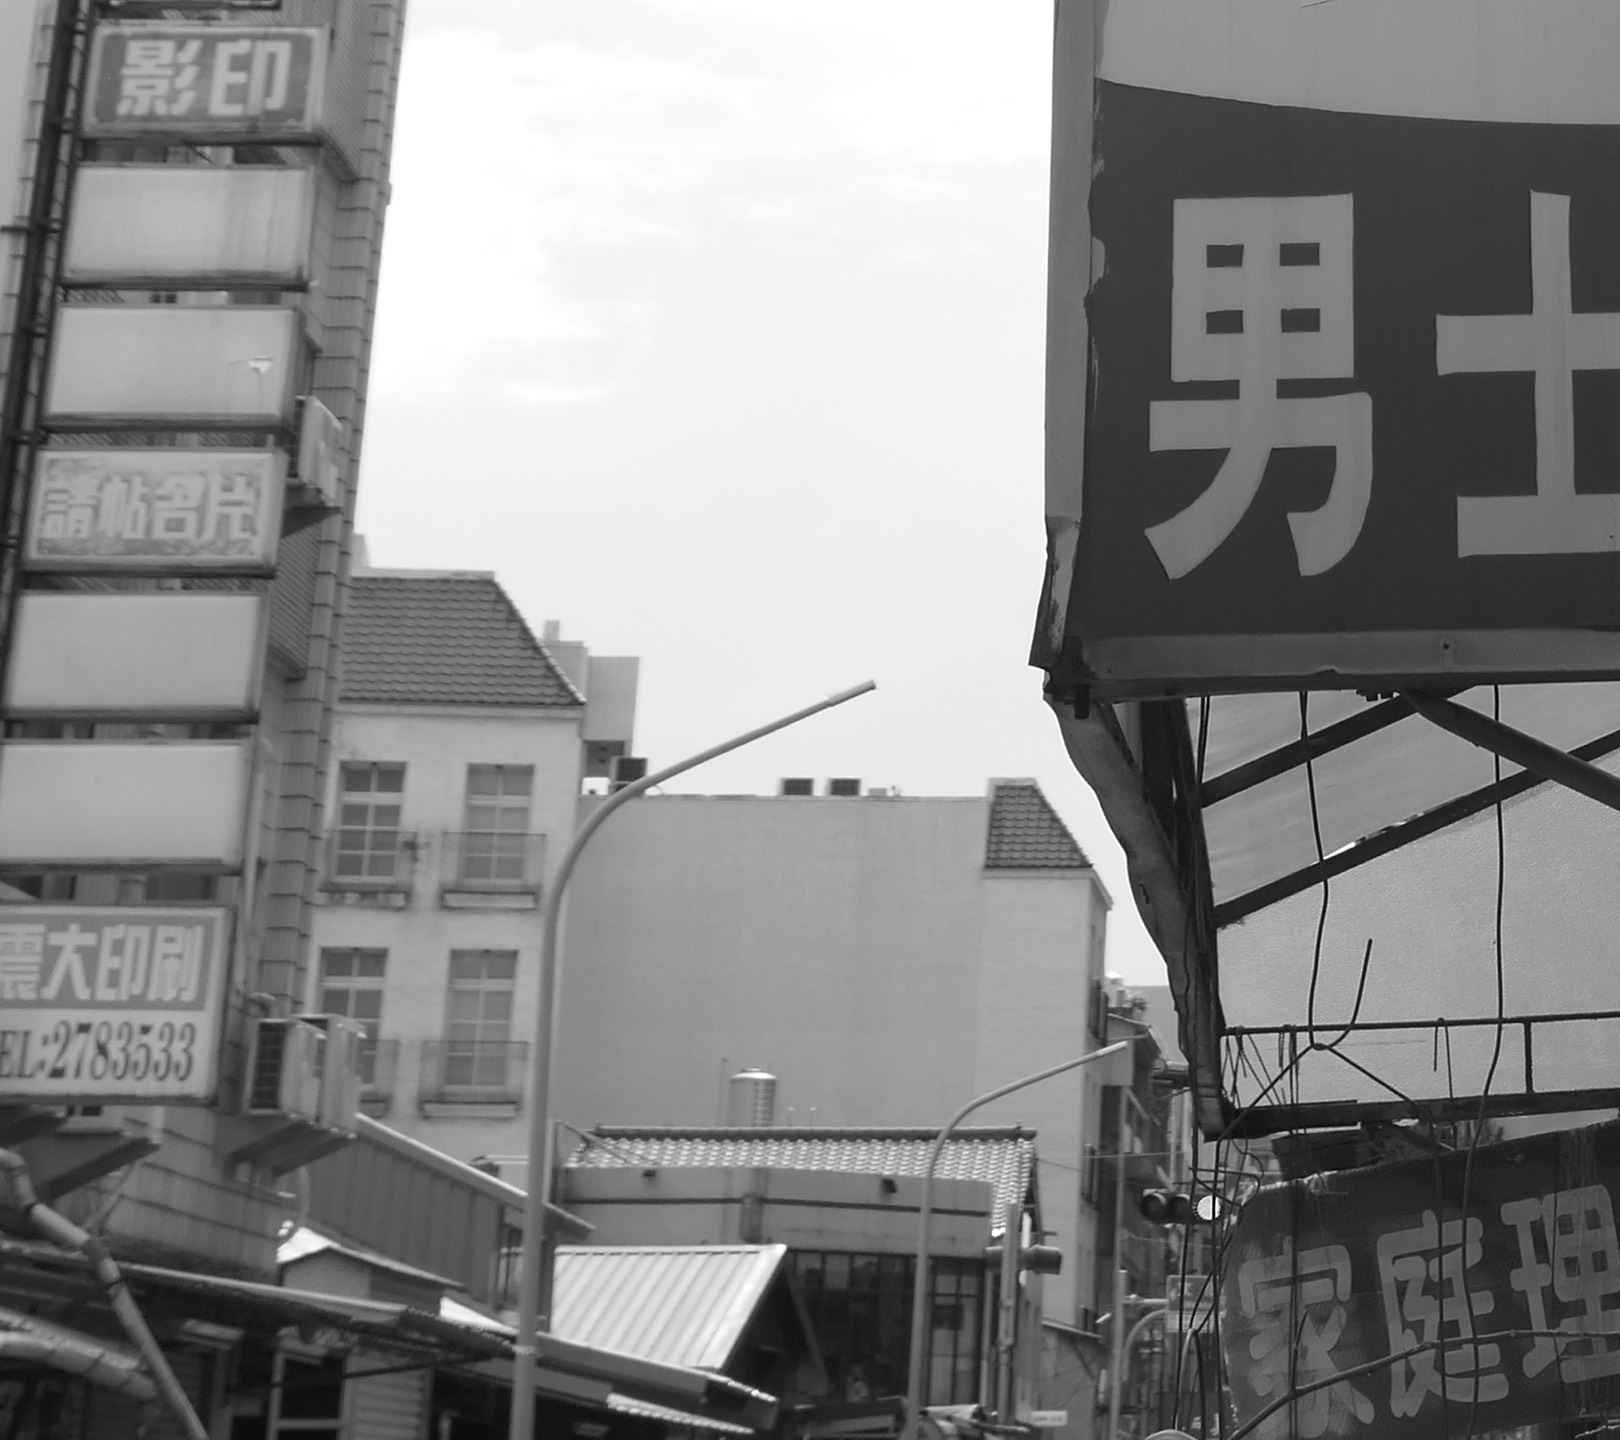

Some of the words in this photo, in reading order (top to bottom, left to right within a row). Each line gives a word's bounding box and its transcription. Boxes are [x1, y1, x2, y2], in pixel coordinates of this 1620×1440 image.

[115, 39, 292, 117] 影印
[42, 473, 268, 544] 請帖名片
